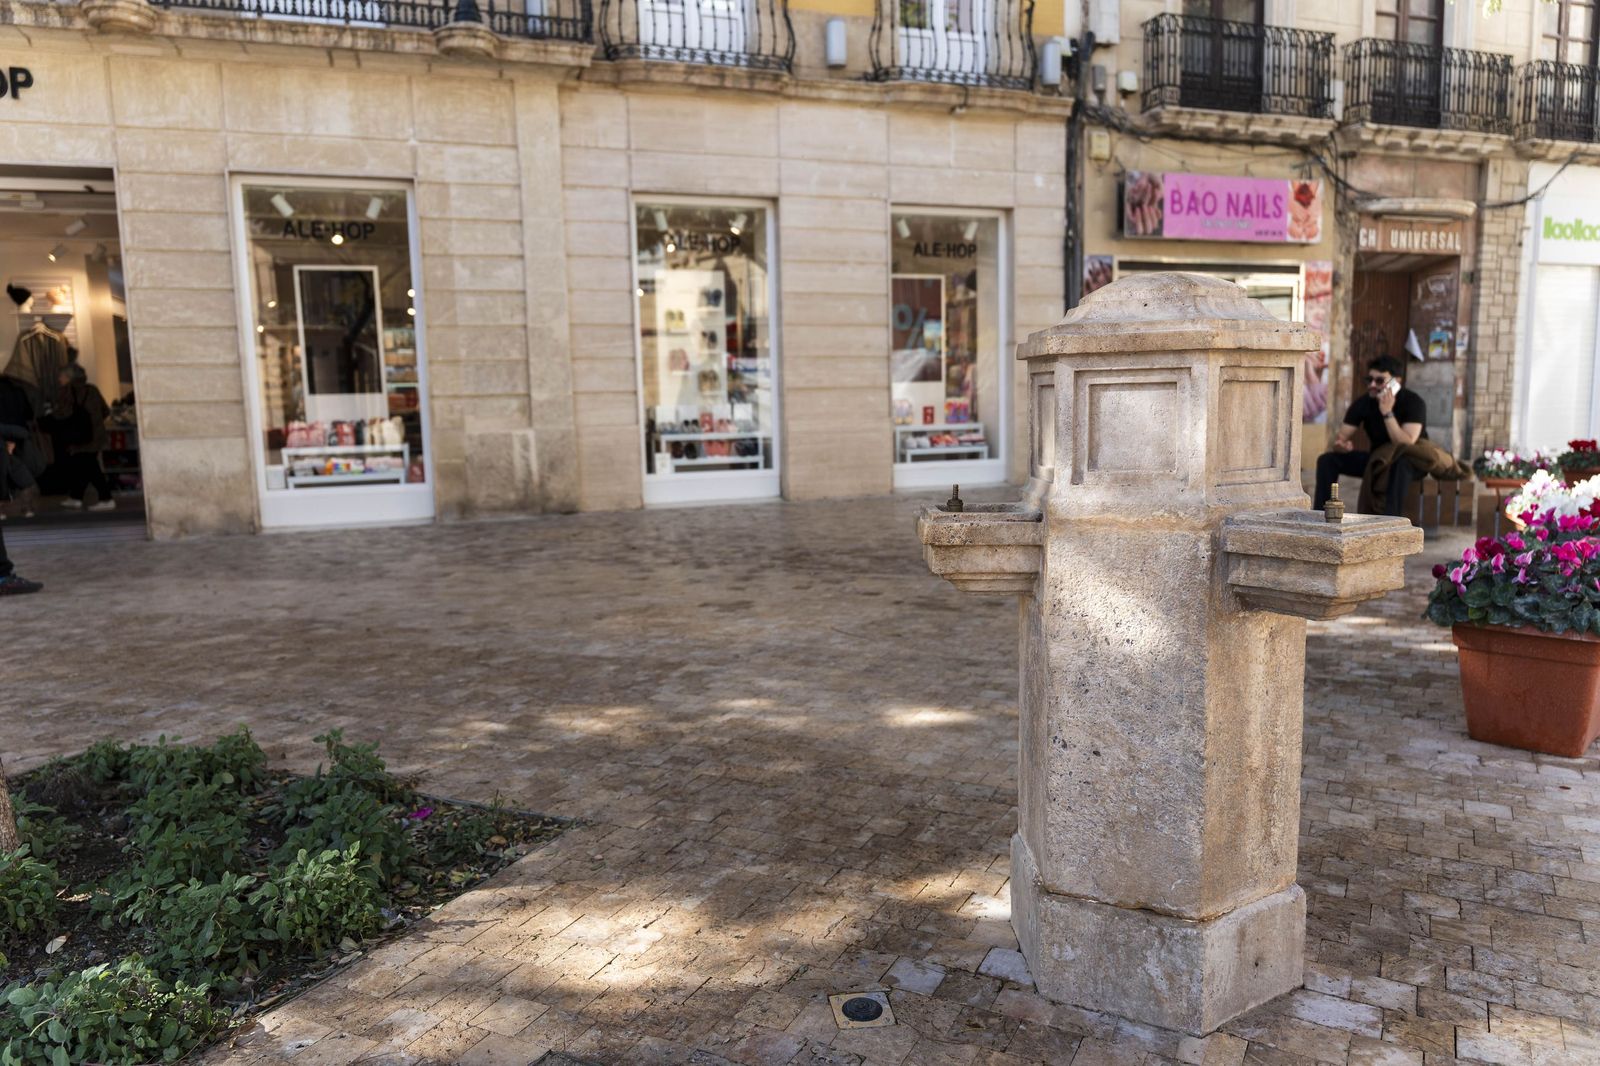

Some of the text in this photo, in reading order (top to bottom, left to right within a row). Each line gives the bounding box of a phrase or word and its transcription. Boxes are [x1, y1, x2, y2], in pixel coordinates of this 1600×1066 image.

[1170, 189, 1283, 219] BAO NAILS
[282, 219, 376, 240] ALE-HOP
[1390, 228, 1461, 251] UNIVERSAL
[913, 240, 977, 259] ALE-HOP
